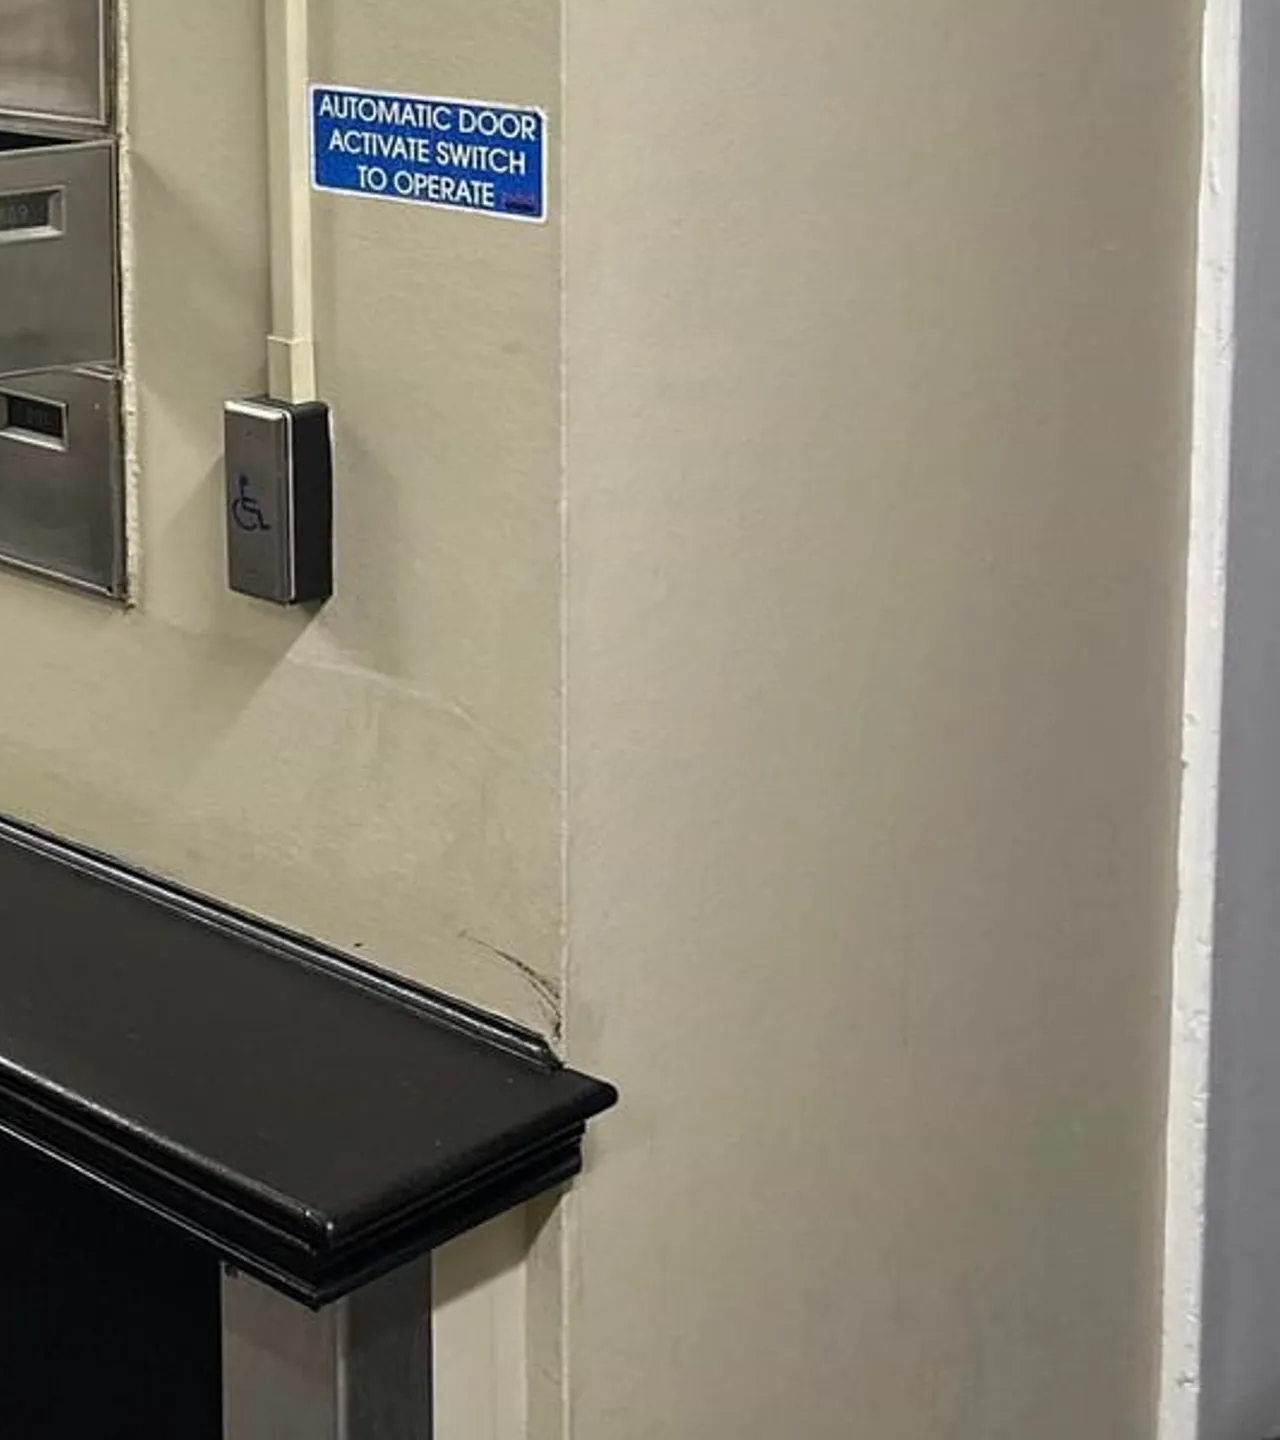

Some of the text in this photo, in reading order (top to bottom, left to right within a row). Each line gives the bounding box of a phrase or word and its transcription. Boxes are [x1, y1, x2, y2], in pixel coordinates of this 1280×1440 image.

[319, 94, 536, 141] AUTOMATIC DOOR
[328, 128, 526, 175] ACTIVATE SWITCH
[357, 165, 495, 208] TO OPERATE
